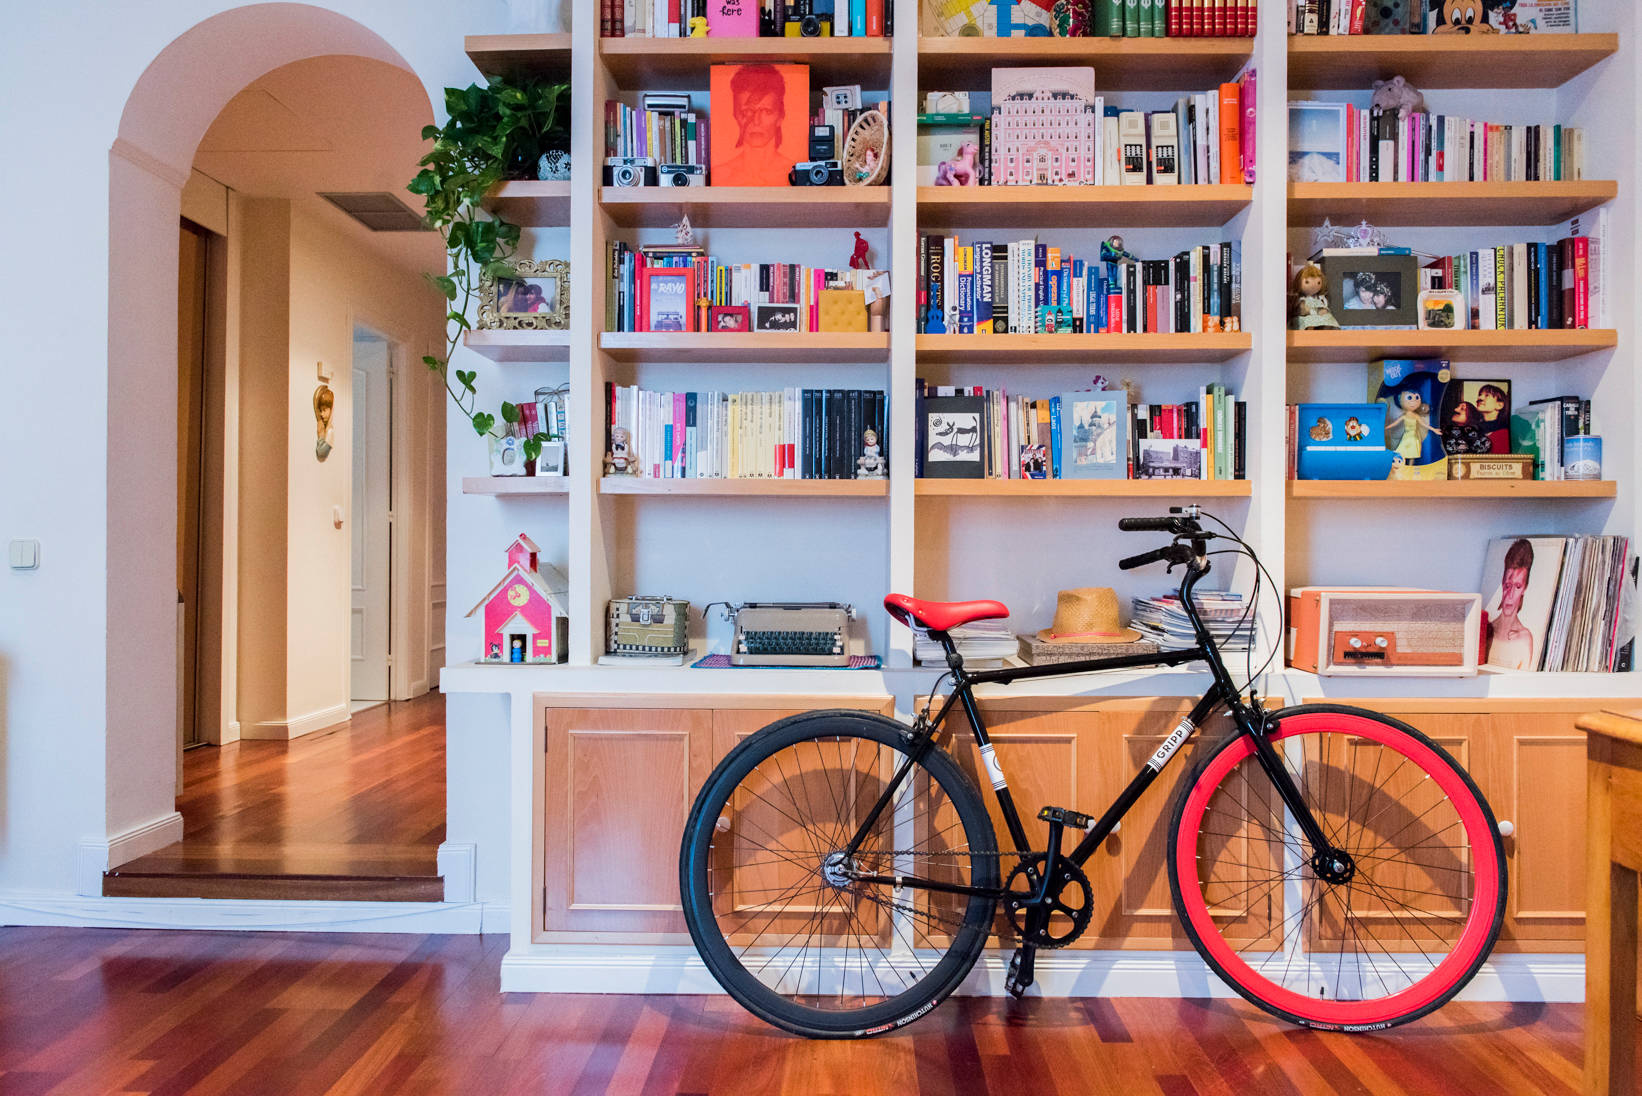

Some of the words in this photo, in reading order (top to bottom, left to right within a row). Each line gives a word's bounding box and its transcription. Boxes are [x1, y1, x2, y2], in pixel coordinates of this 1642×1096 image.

[719, 6, 742, 17] here
[982, 243, 991, 302] LONGMAN
[1497, 248, 1505, 276] CHUCK
[657, 282, 686, 295] RAYO
[1497, 281, 1505, 328] PALAHNIUK
[1479, 463, 1513, 471] BISCUITS
[1156, 729, 1183, 760] GRIPP
[896, 1003, 934, 1027] HUTCHINSON
[1343, 1023, 1386, 1032] HUTCHINSON
